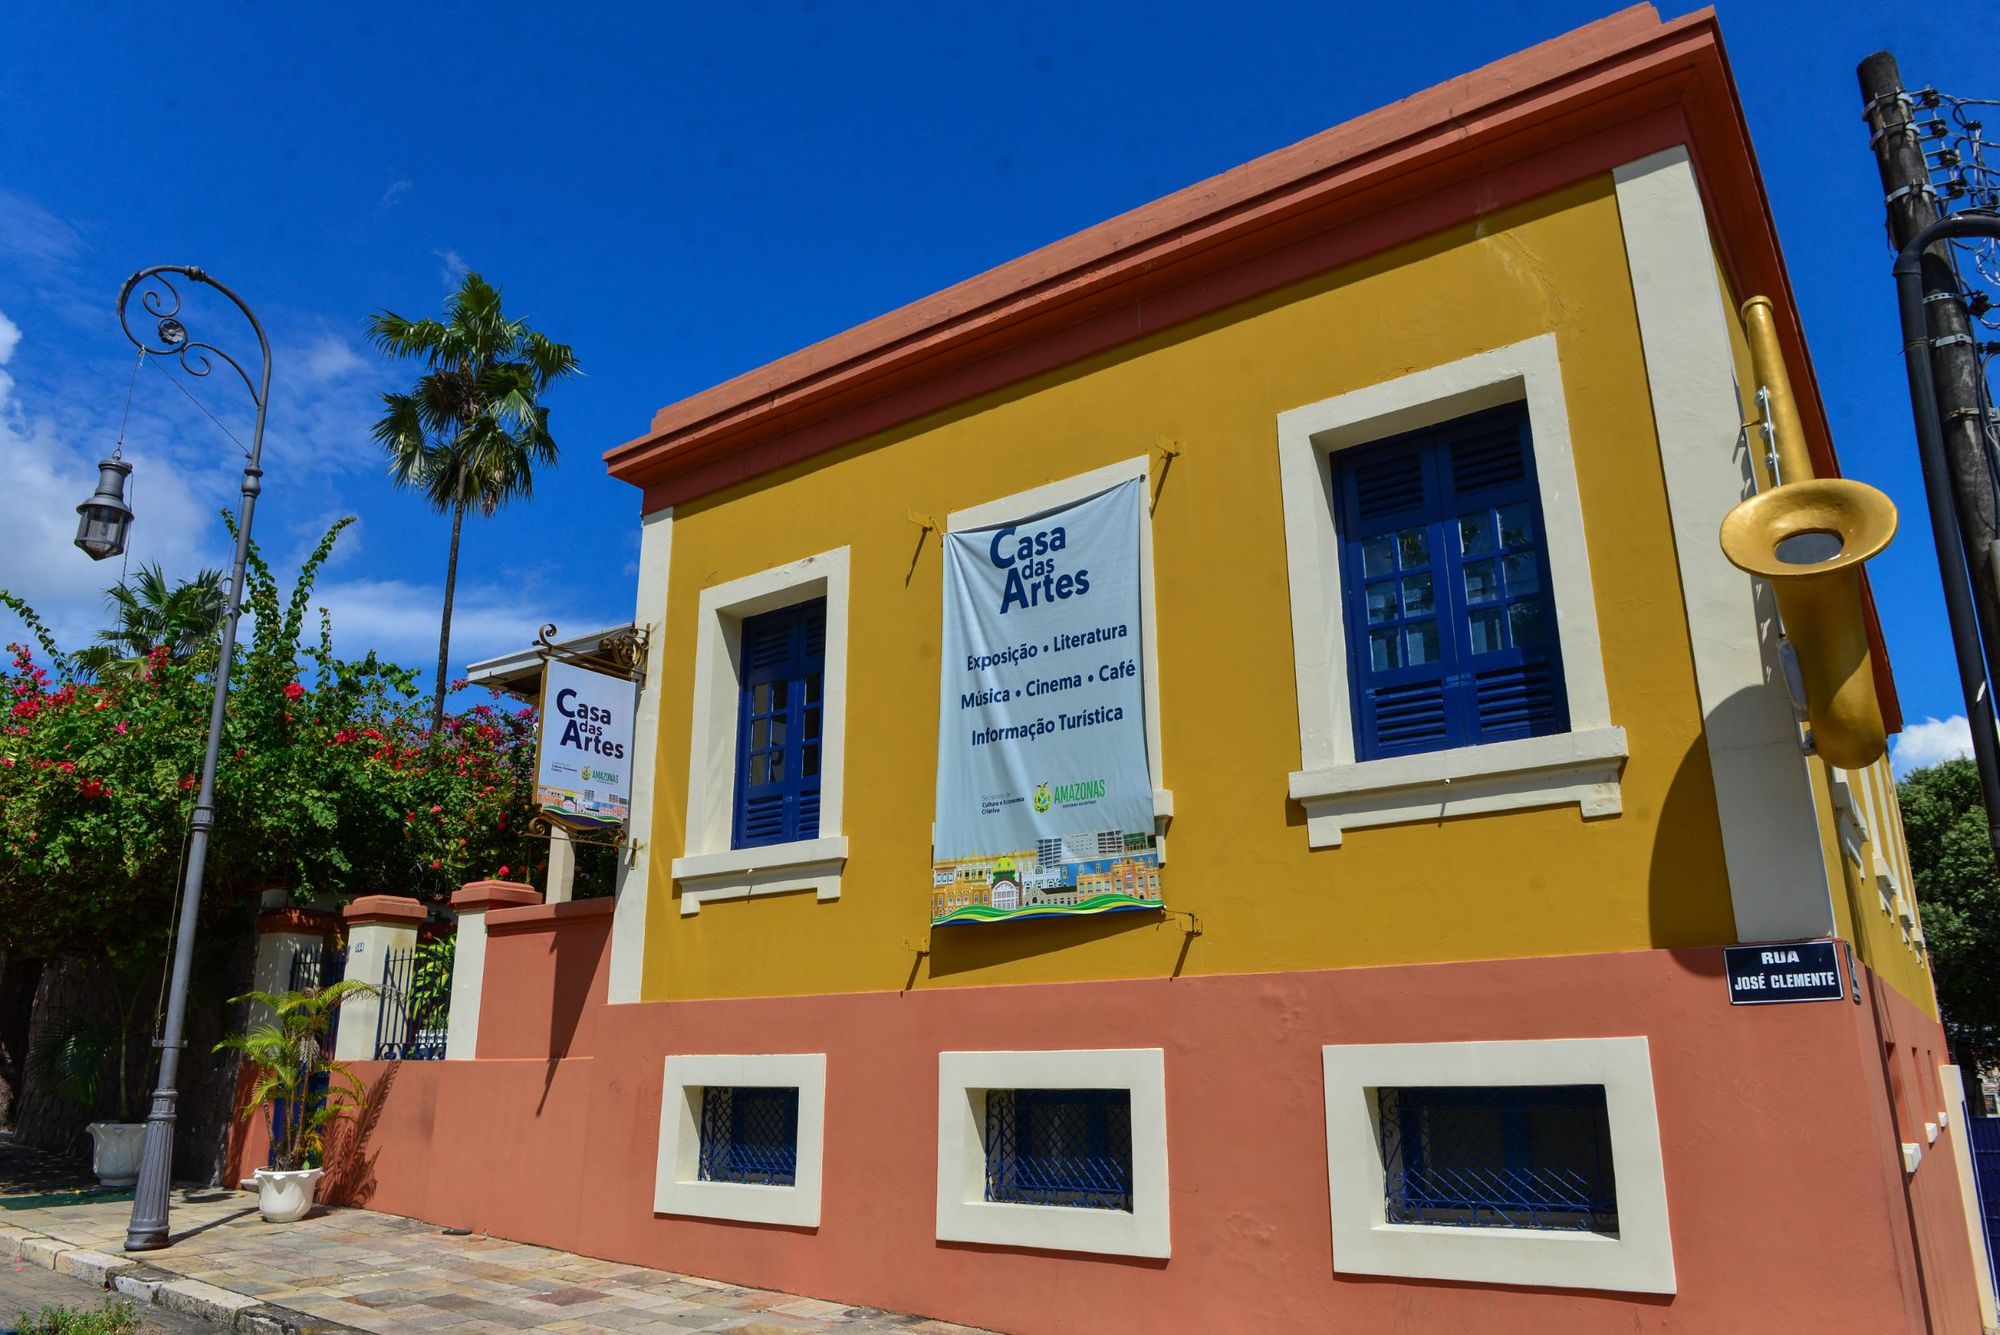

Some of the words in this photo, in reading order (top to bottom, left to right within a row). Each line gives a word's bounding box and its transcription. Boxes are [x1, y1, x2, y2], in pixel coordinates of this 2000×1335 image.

[989, 527, 1067, 569] Casa
[1021, 558, 1055, 580] das
[1000, 567, 1090, 614] Artes
[967, 643, 1038, 671] Exposição
[1054, 624, 1128, 653] Literatura
[961, 688, 1010, 709] Música
[1026, 674, 1082, 697] Cinema
[1099, 659, 1137, 682] Café
[556, 688, 611, 725] Casa
[560, 719, 624, 759] Artes
[579, 720, 603, 736] das
[972, 718, 1055, 746] Informação
[1059, 706, 1123, 731] Turística
[1054, 779, 1105, 804] AMAZONAS
[1761, 951, 1799, 964] RUA
[1735, 973, 1766, 990] JOSÉ
[1770, 972, 1835, 988] CLEMENTE
